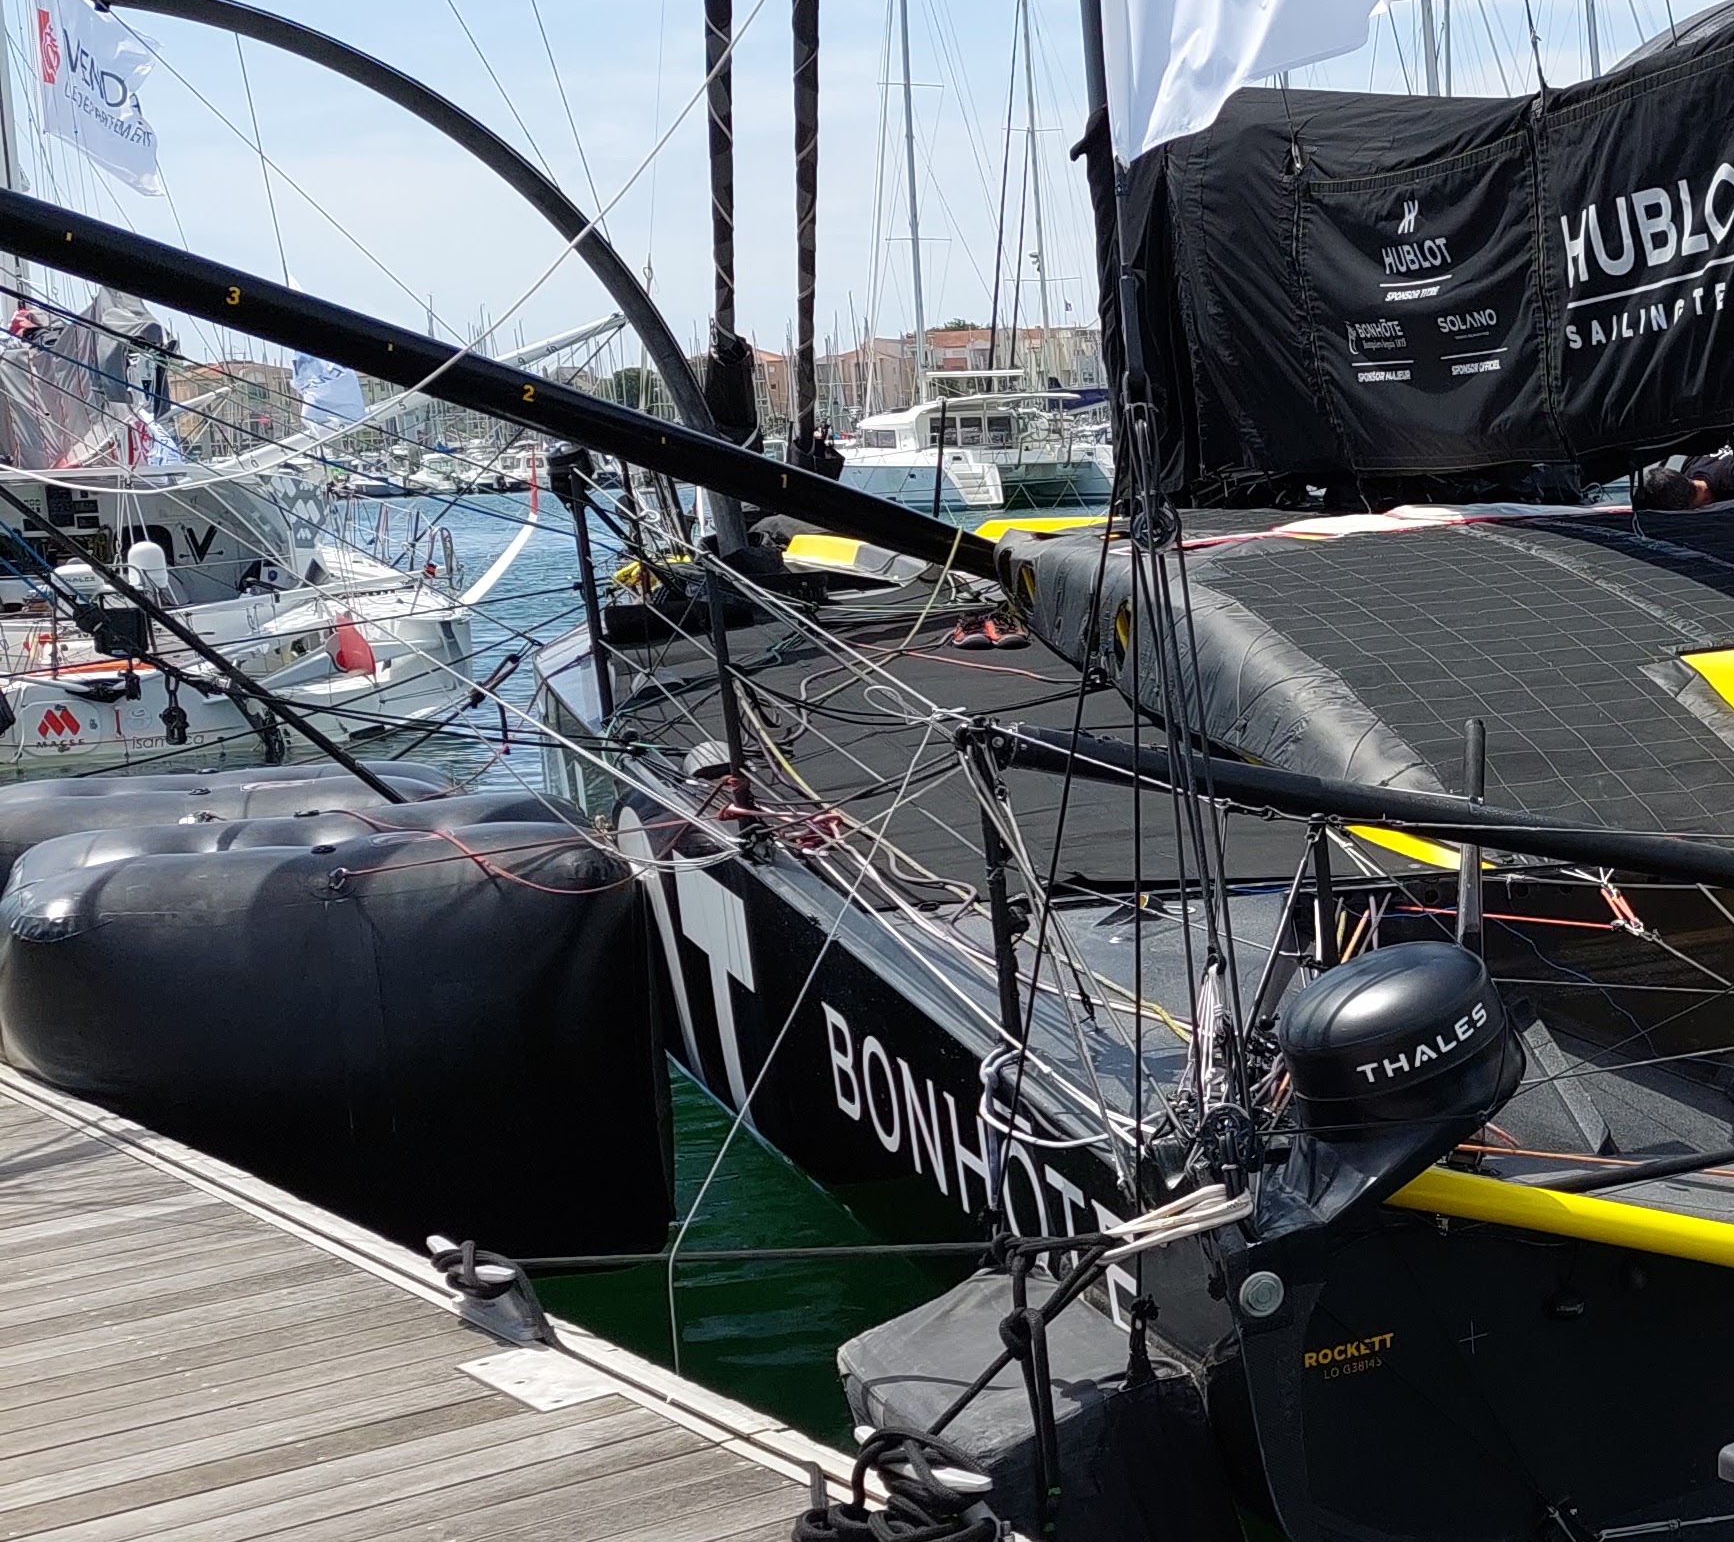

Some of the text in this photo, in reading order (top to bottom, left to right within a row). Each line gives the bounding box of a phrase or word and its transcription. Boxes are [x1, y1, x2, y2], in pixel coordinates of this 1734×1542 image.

[1381, 236, 1453, 275] HUBLOT
[225, 286, 241, 305] 3
[1437, 308, 1497, 333] SOLANO
[522, 384, 536, 403] 2
[1356, 1002, 1488, 1083] THALES
